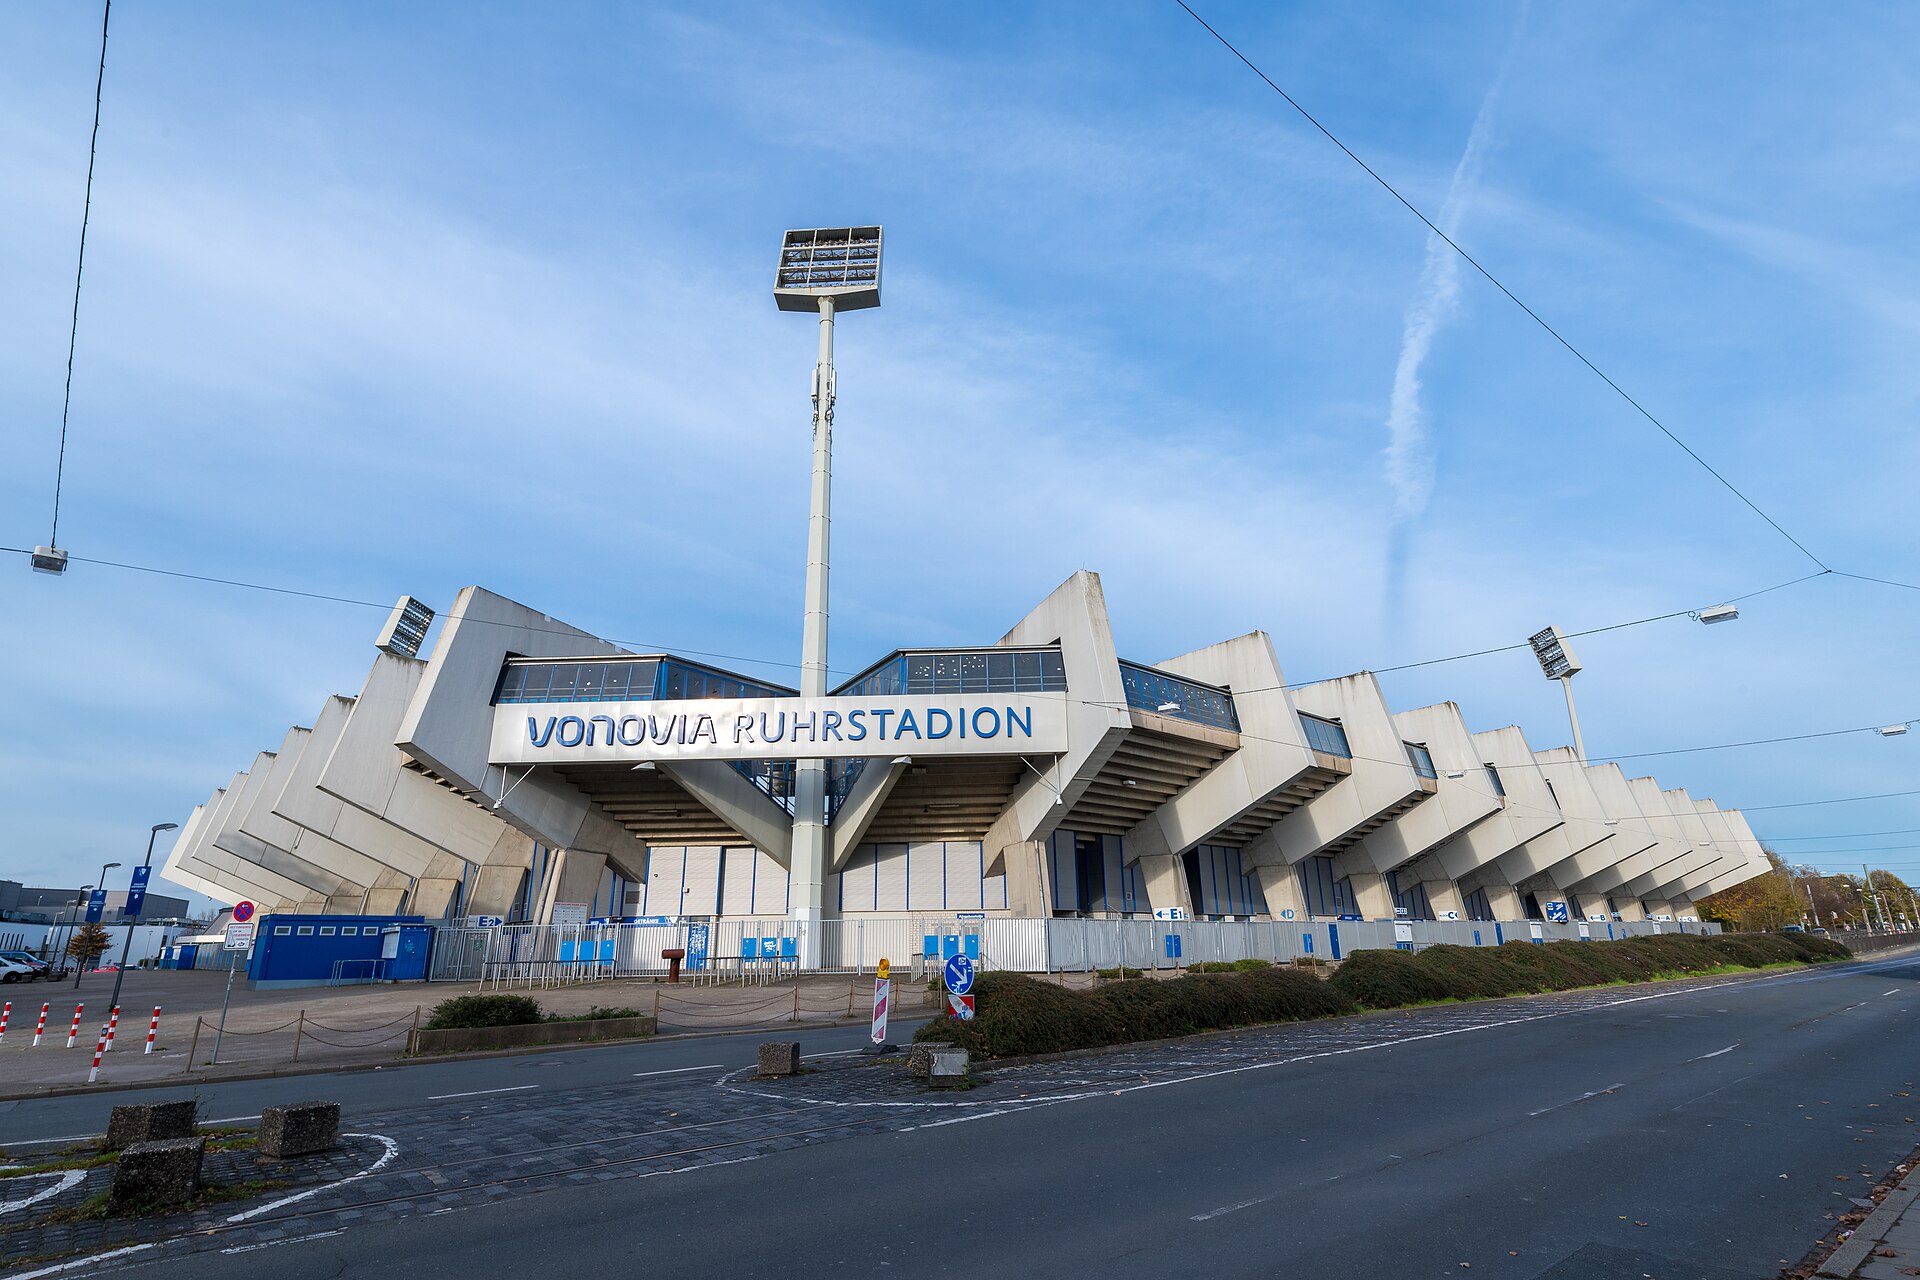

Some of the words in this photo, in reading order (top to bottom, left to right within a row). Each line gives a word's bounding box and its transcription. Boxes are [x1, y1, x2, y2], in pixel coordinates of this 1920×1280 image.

[732, 706, 1032, 744] RUHRSTADION
[1170, 908, 1182, 919] E1
[1287, 909, 1295, 919] D
[1447, 911, 1455, 919] C
[479, 916, 495, 926] E2
